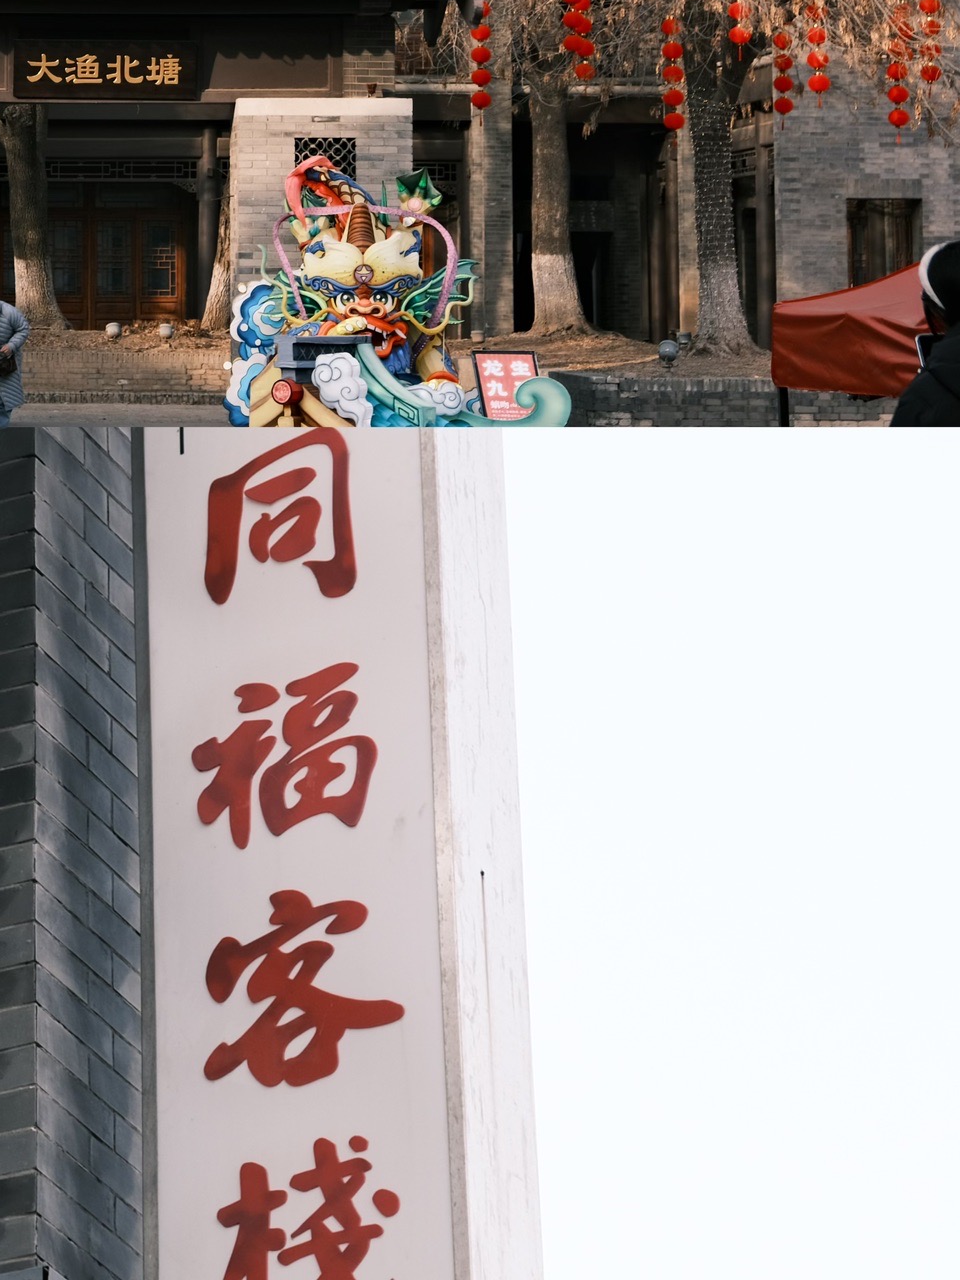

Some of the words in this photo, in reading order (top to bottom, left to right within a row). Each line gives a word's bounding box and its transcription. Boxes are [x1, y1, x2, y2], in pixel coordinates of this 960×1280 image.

[26, 53, 183, 86] 大渔北塘
[482, 359, 532, 377] 龙生
